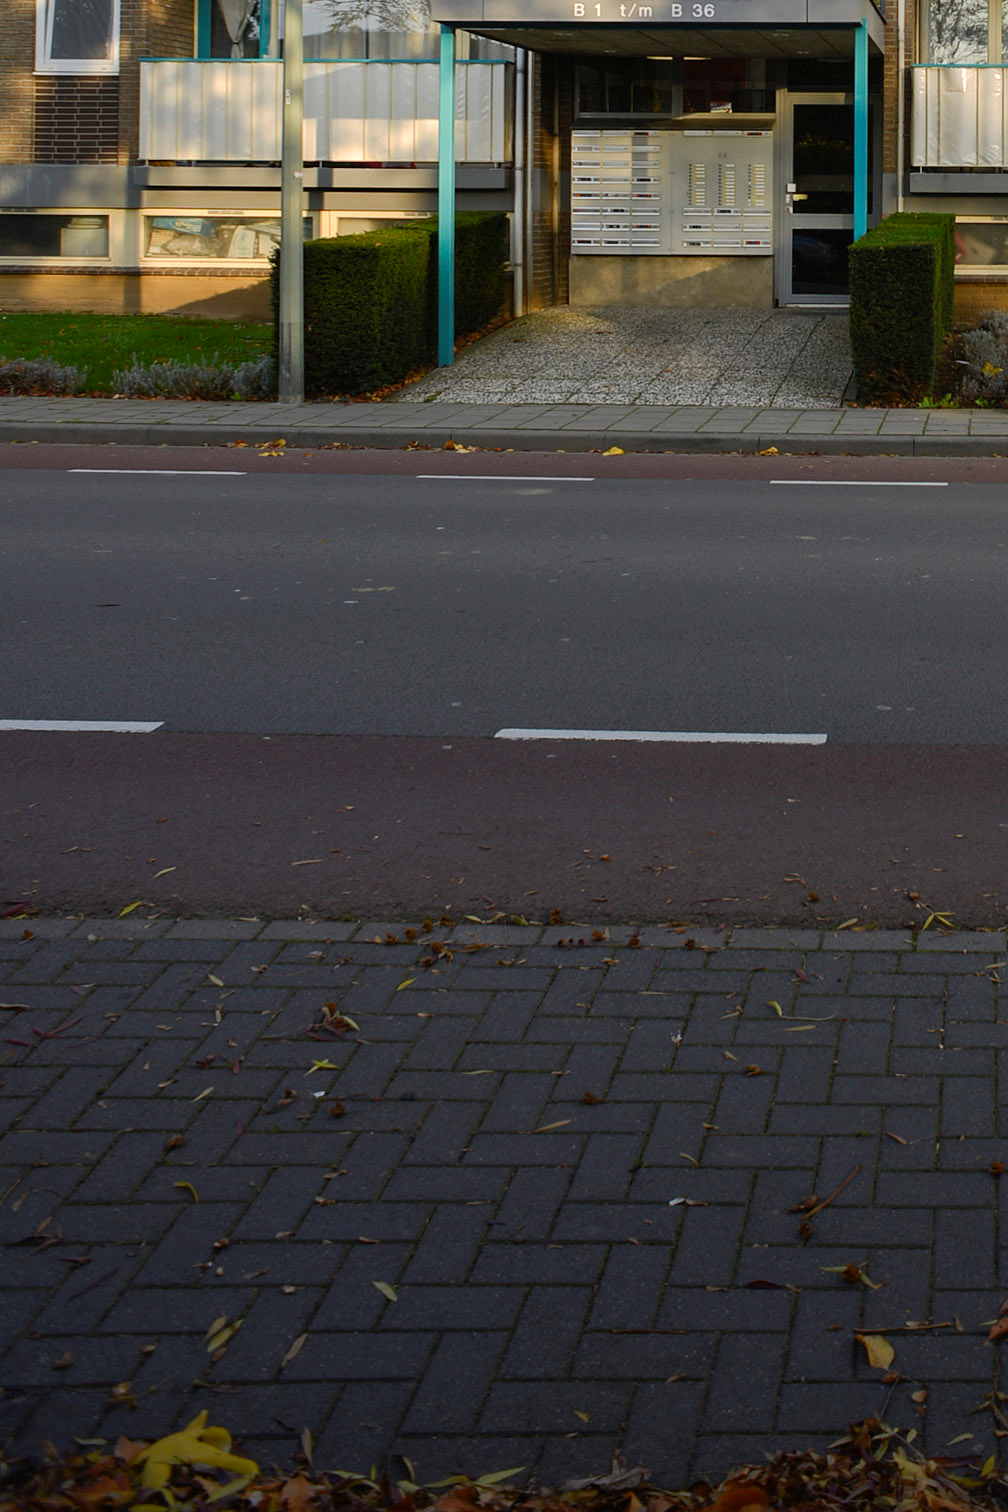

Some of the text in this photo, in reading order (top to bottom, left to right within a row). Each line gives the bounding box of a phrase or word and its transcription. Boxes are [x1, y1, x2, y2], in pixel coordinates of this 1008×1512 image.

[573, 3, 716, 17] B 1 t/m B 36
